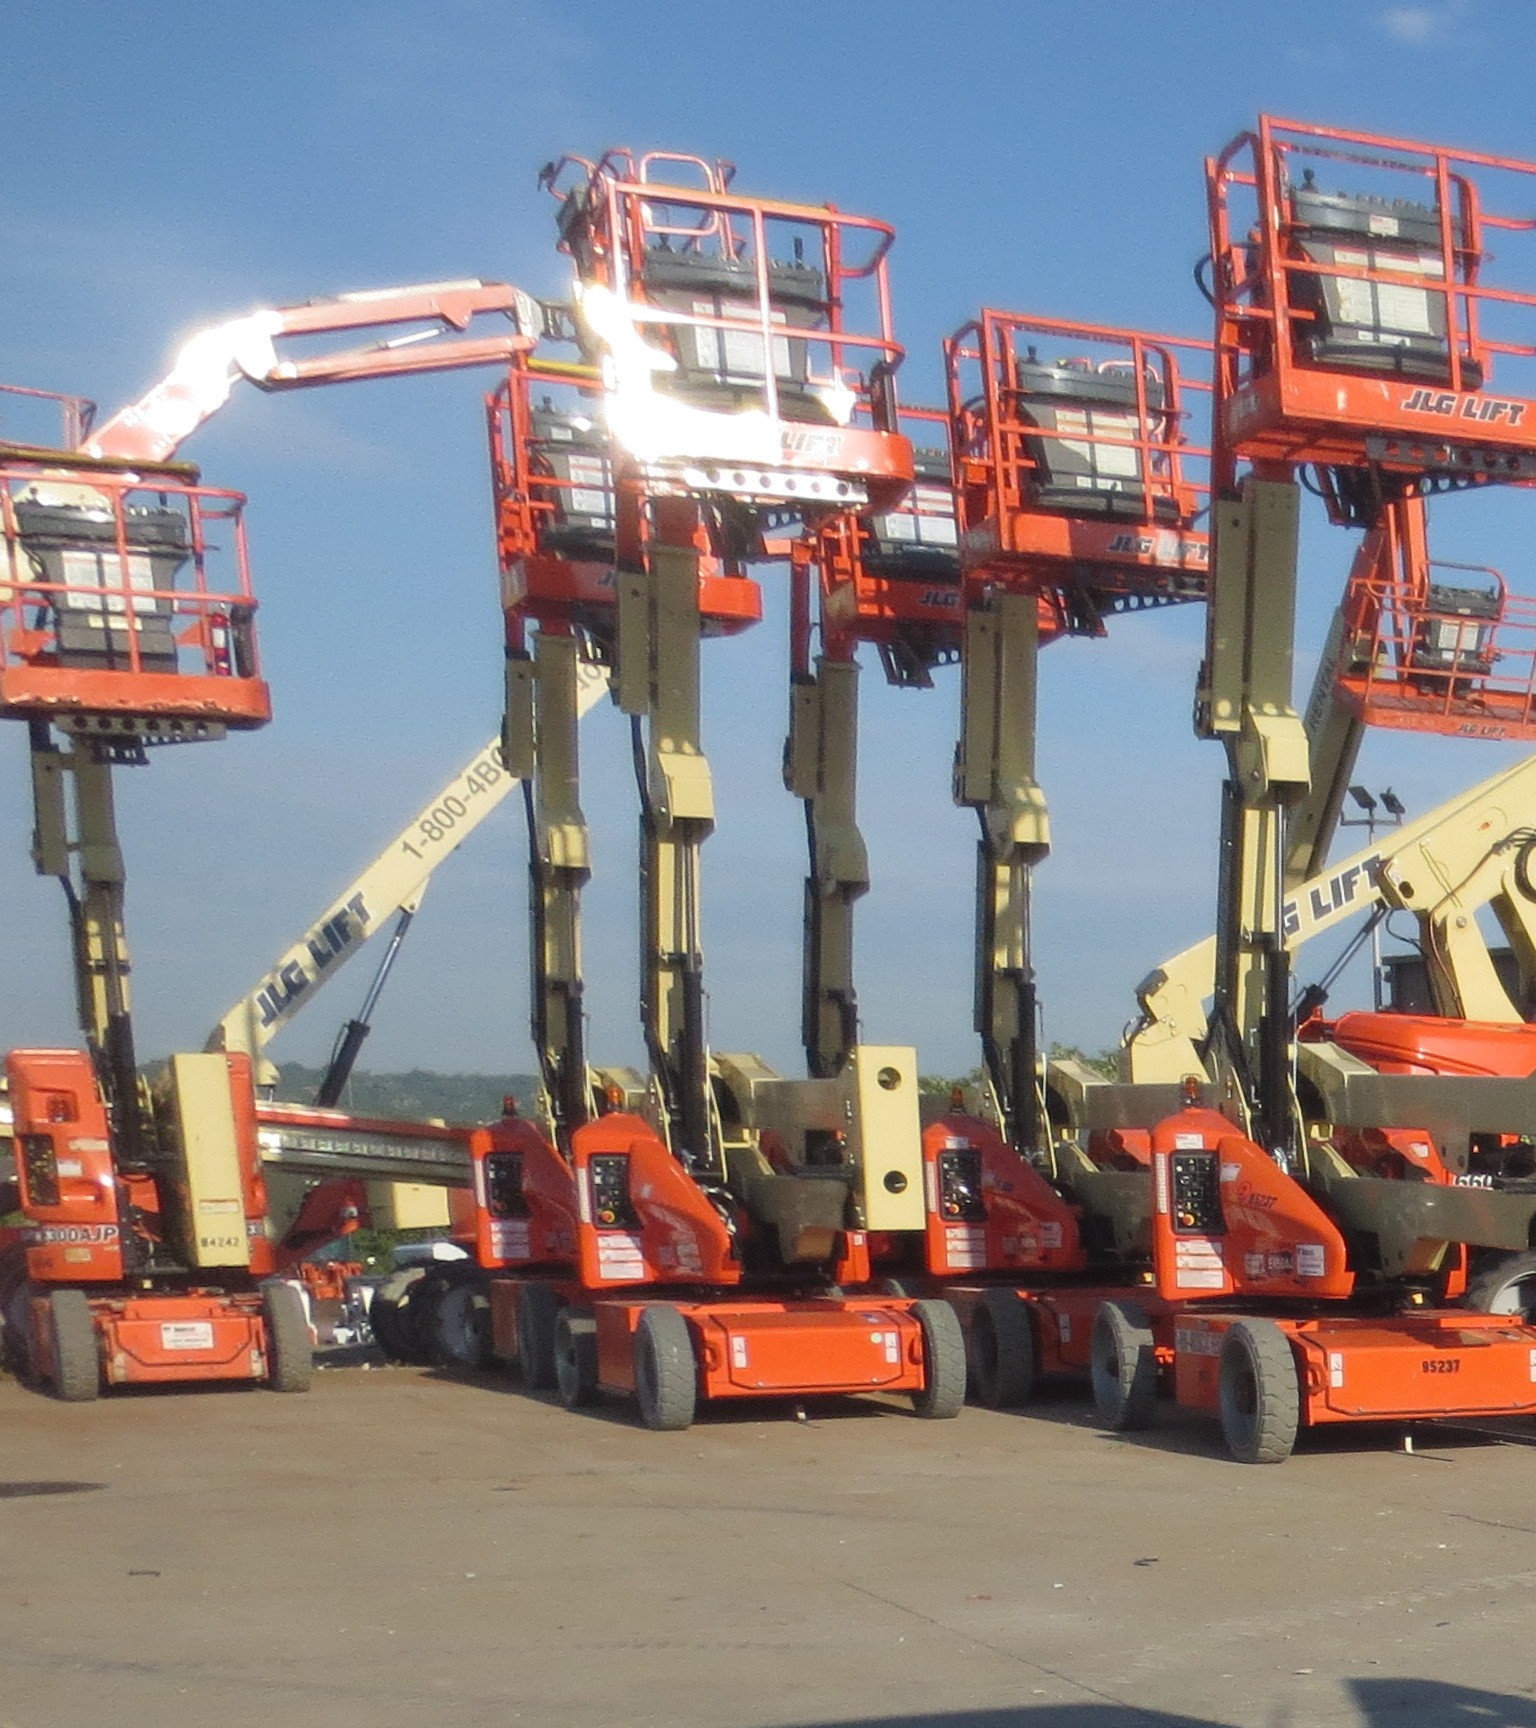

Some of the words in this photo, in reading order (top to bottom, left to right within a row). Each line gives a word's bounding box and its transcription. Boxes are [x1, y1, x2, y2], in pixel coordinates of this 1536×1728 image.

[1402, 388, 1457, 416] JLG
[1460, 395, 1527, 426] LIFT
[256, 958, 311, 1028] JLG
[305, 890, 371, 970] LIFT
[1422, 1359, 1460, 1373] 95237
